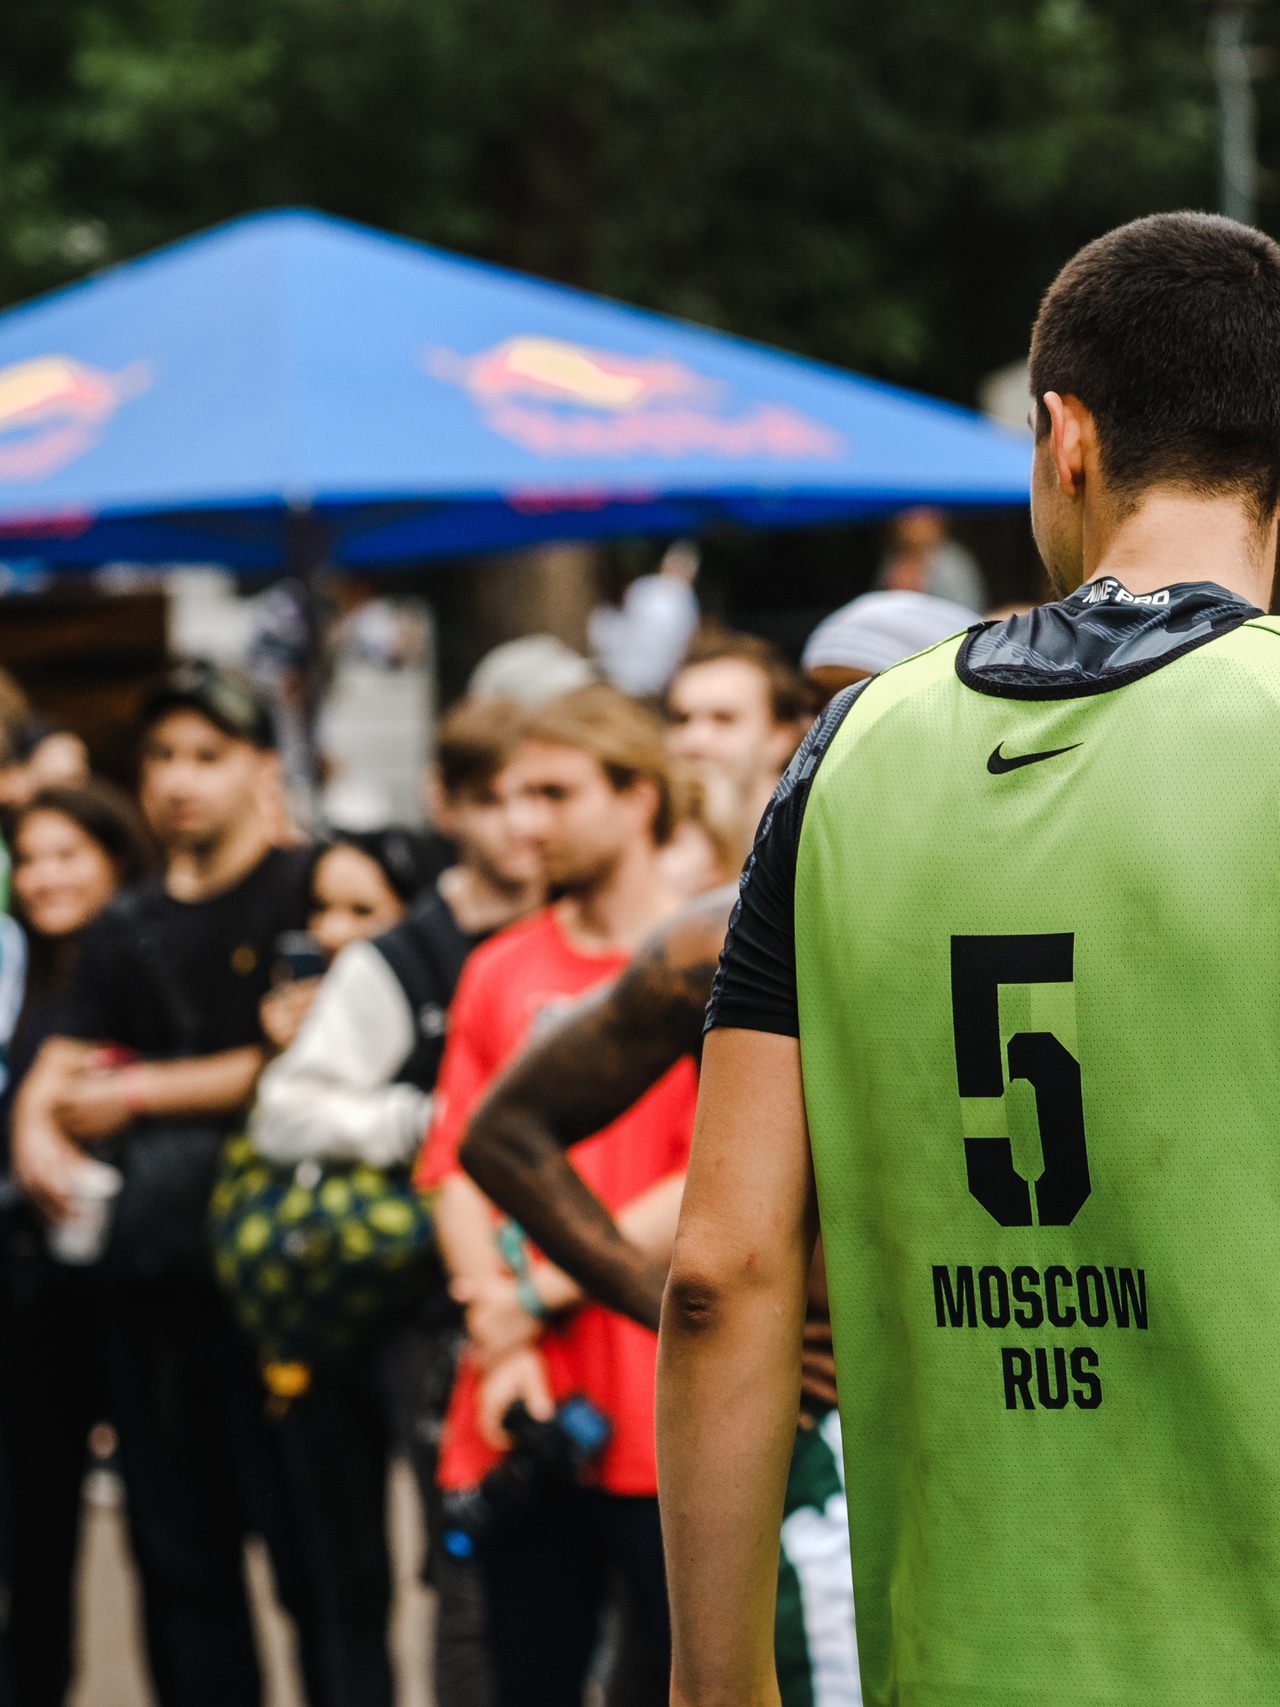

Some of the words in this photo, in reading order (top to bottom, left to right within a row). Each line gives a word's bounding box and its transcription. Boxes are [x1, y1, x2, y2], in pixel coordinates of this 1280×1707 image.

[1115, 588, 1170, 605] PRO
[951, 932, 1091, 1227] 5
[931, 1265, 1149, 1330] MOSCOW
[1001, 1347, 1103, 1410] RUS
